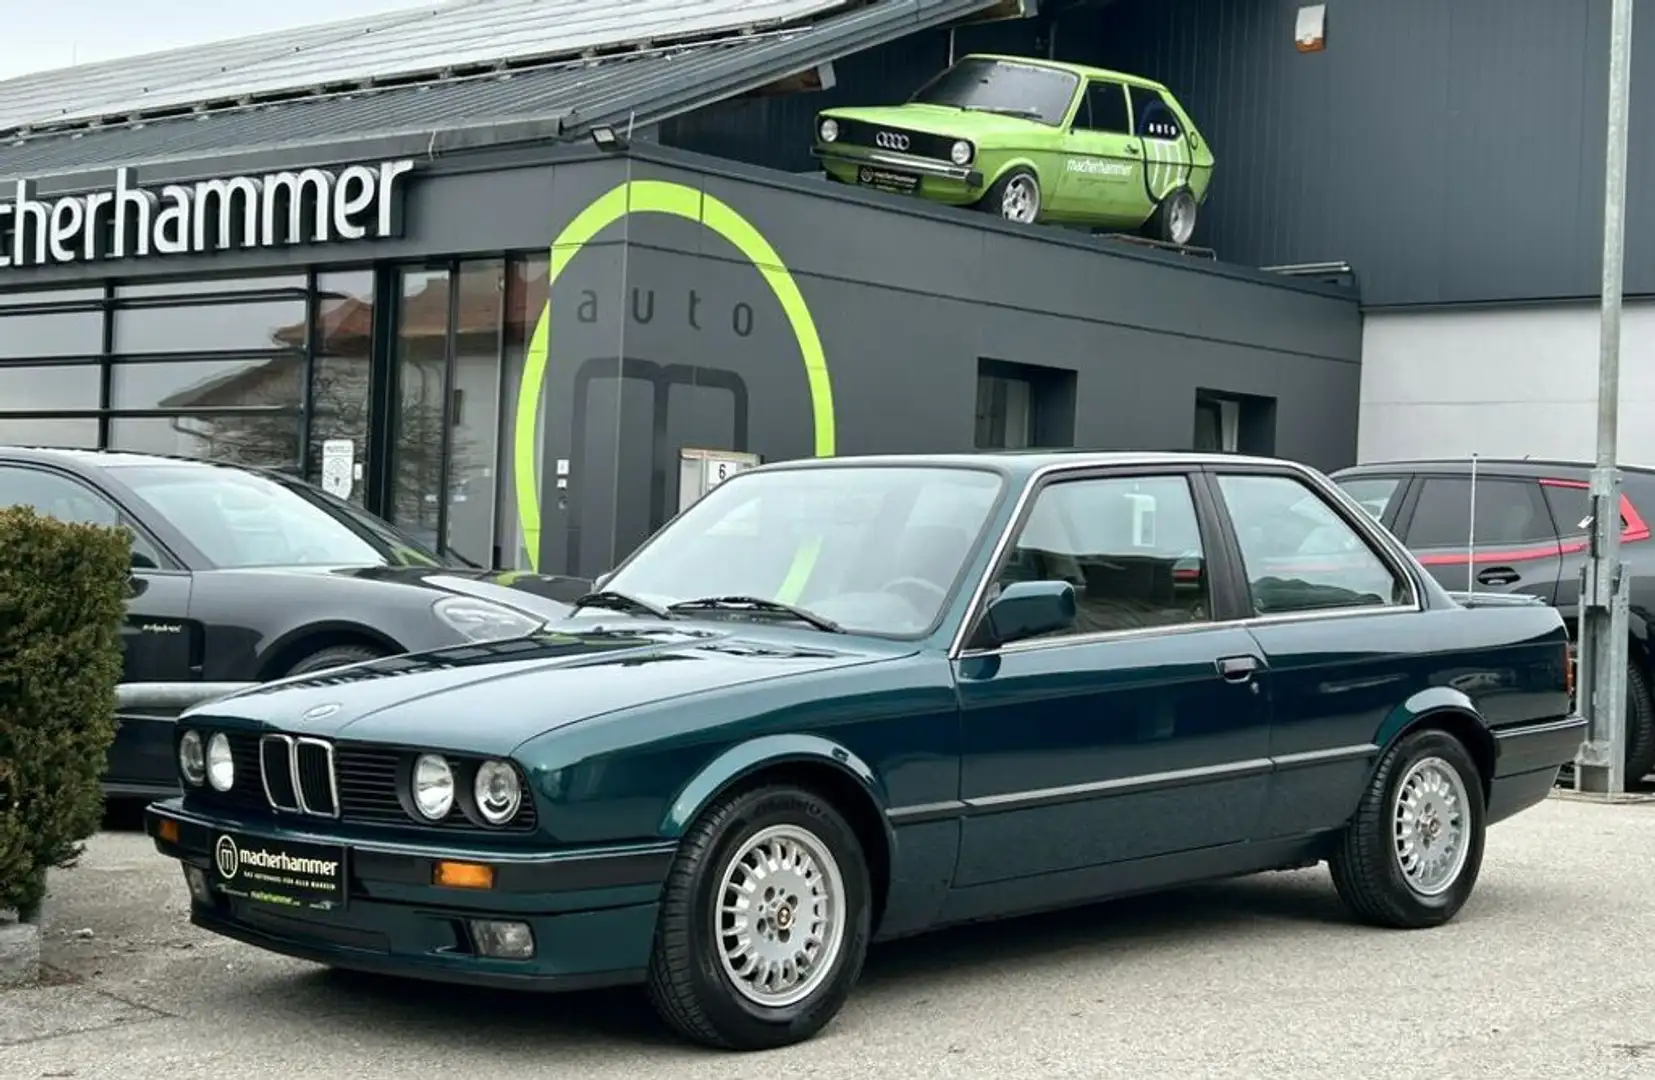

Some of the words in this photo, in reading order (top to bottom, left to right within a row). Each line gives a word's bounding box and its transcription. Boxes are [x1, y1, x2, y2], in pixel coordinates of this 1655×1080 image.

[577, 286, 755, 338] auto
[719, 463, 727, 480] 6
[240, 848, 338, 876] macherhammer
